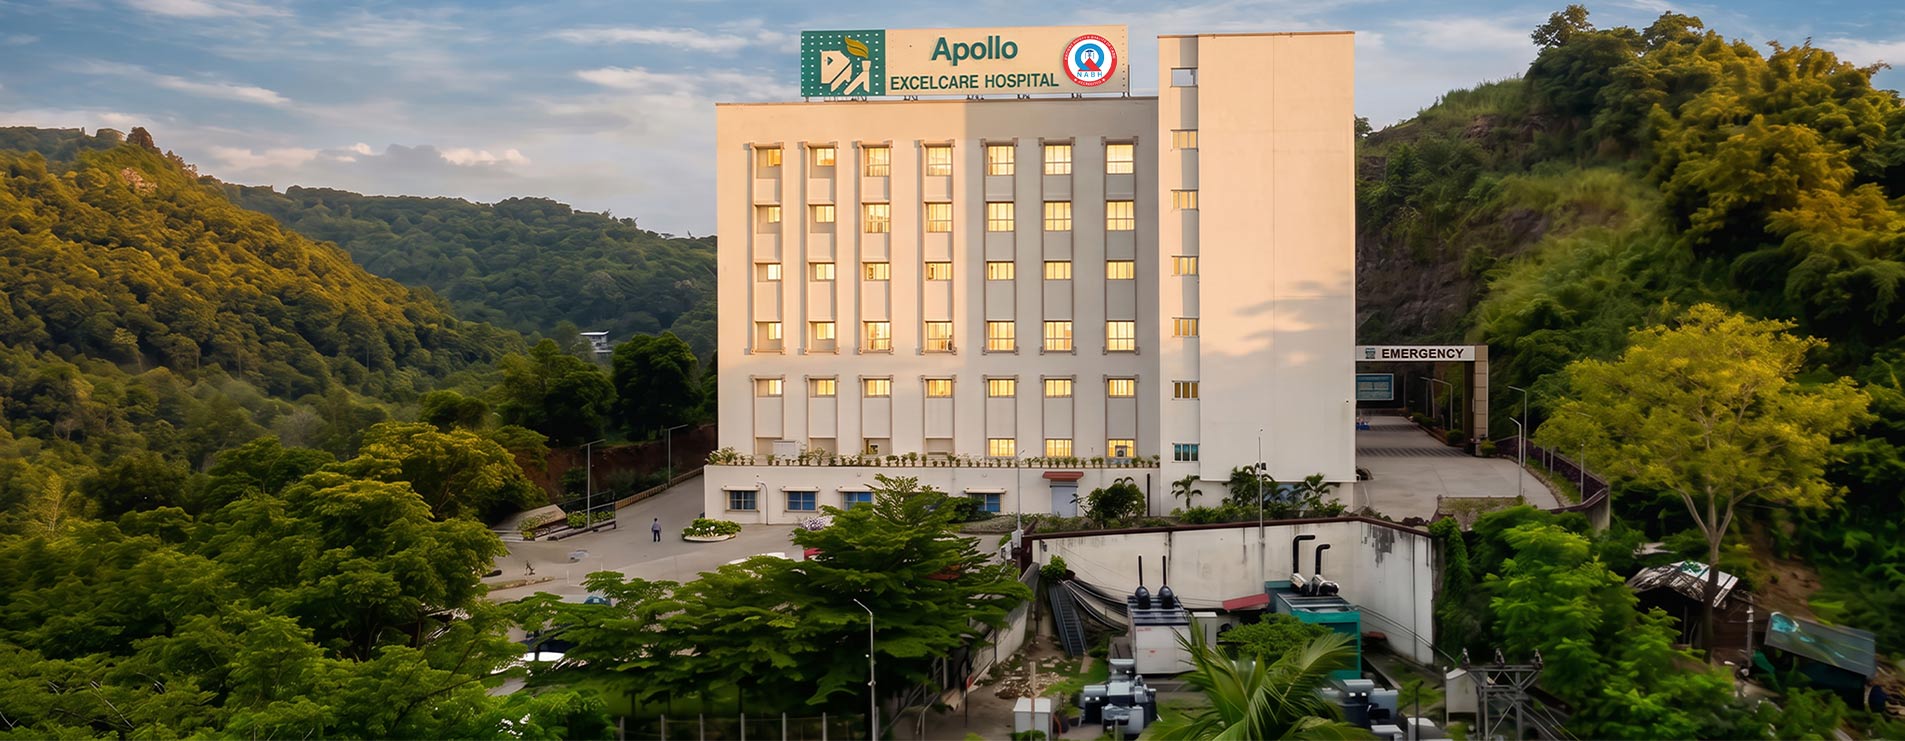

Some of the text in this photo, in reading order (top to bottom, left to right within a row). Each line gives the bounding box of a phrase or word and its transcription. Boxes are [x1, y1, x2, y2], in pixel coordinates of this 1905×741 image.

[931, 36, 1018, 66] Apollo
[891, 73, 1059, 90] EXCELCARE HOSPITAL
[1381, 348, 1464, 359] EMERGENCY
